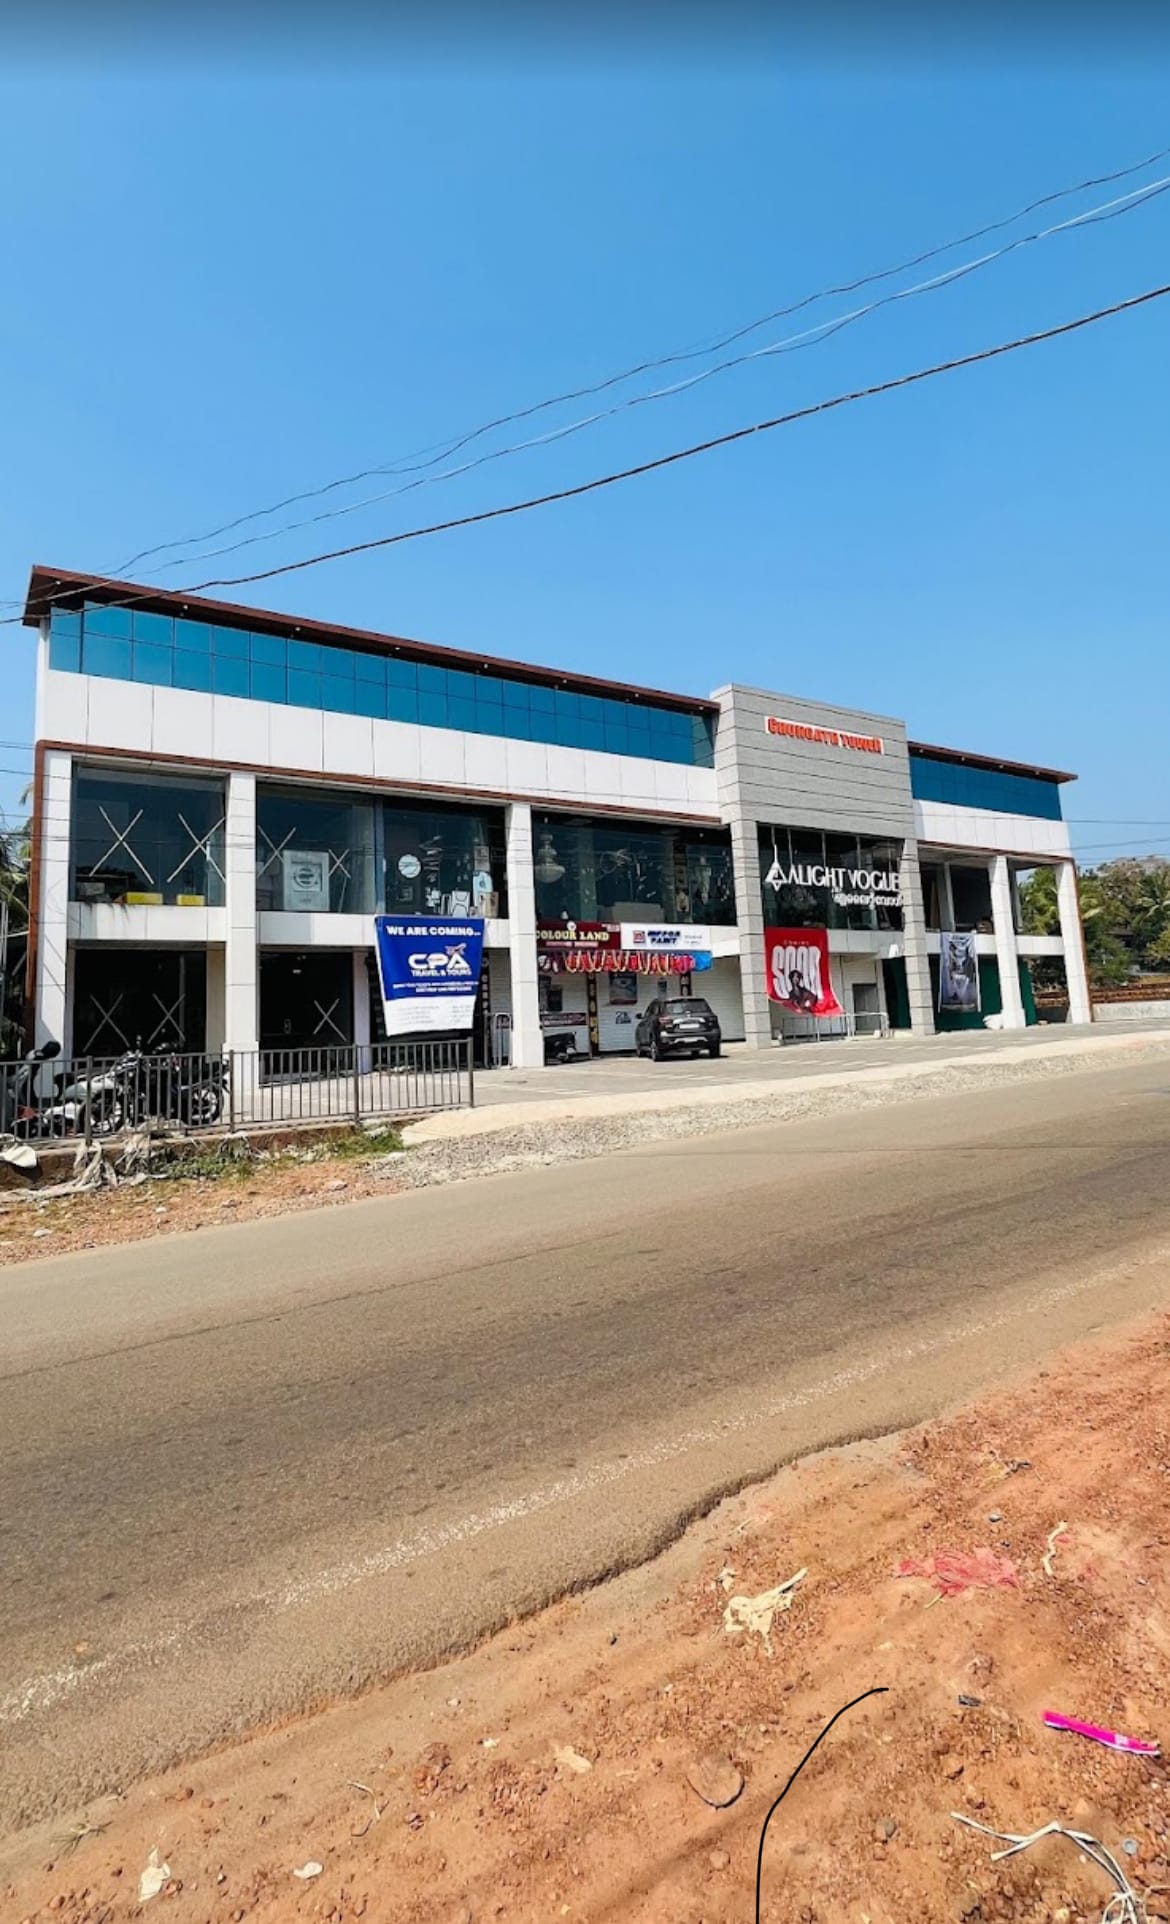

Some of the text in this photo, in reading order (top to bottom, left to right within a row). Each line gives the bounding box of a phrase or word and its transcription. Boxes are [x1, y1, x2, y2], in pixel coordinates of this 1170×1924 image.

[788, 863, 900, 892] ALIGHT VOGUE
[386, 925, 404, 936] WE
[406, 926, 428, 936] ARE
[579, 931, 609, 941] LAND
[408, 953, 470, 970] CPA
[411, 969, 438, 977] TRAVEL
